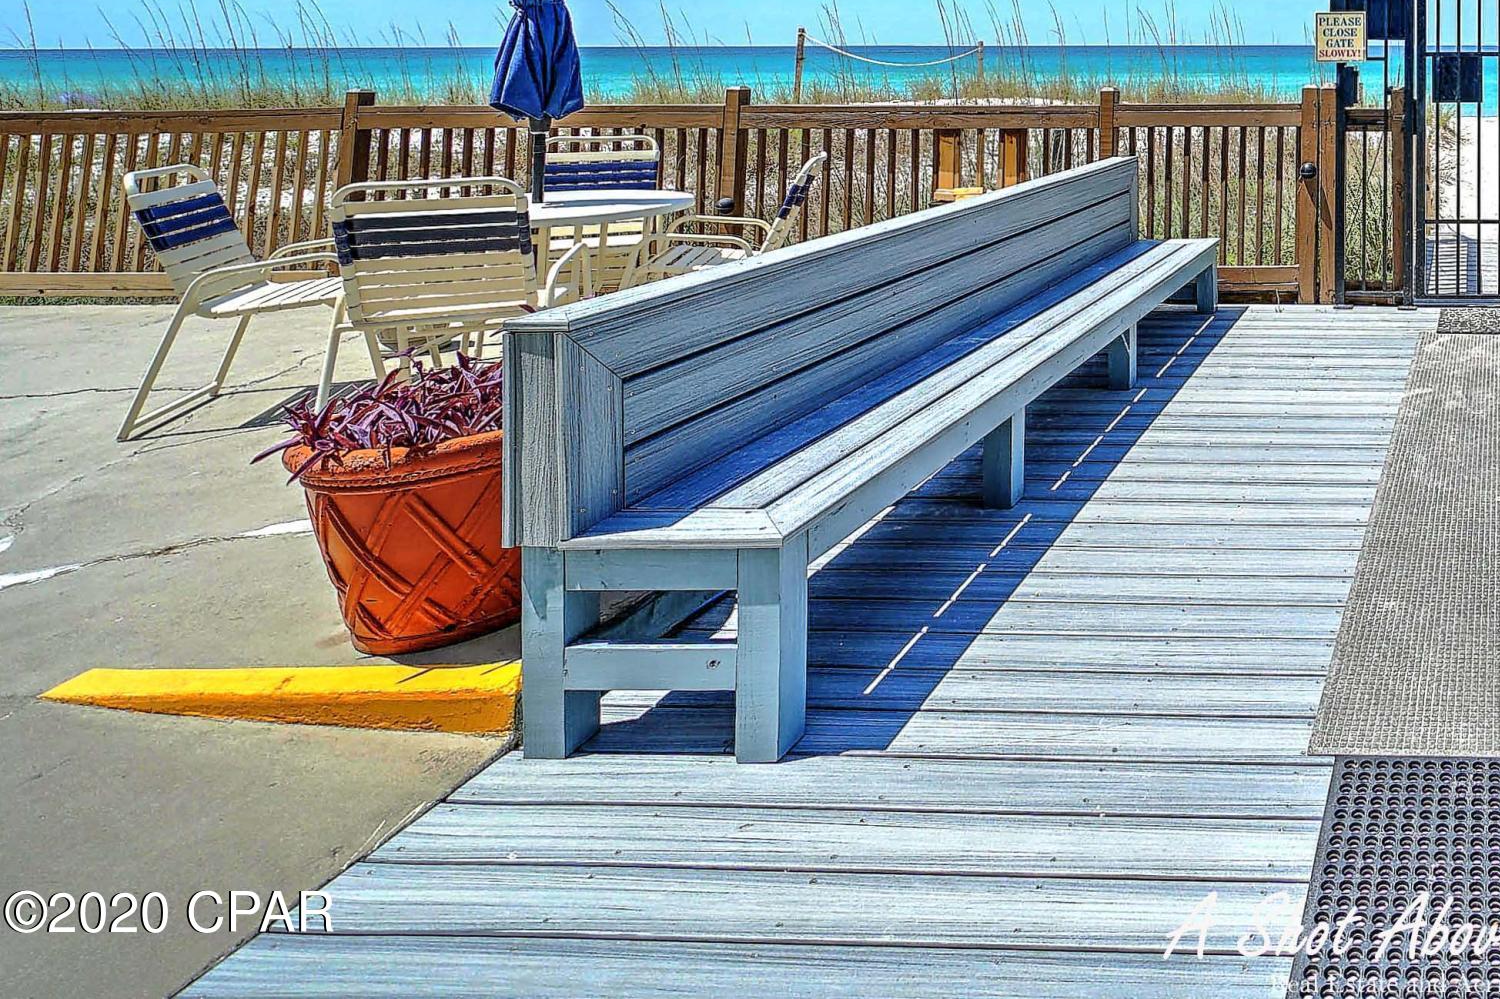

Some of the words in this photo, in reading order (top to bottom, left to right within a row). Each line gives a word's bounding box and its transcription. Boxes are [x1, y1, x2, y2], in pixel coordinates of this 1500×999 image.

[1319, 17, 1361, 26] PLEASE
[1323, 28, 1357, 37] CLOSE
[1326, 39, 1354, 48] GATE
[1319, 50, 1361, 58] SLOWLY!
